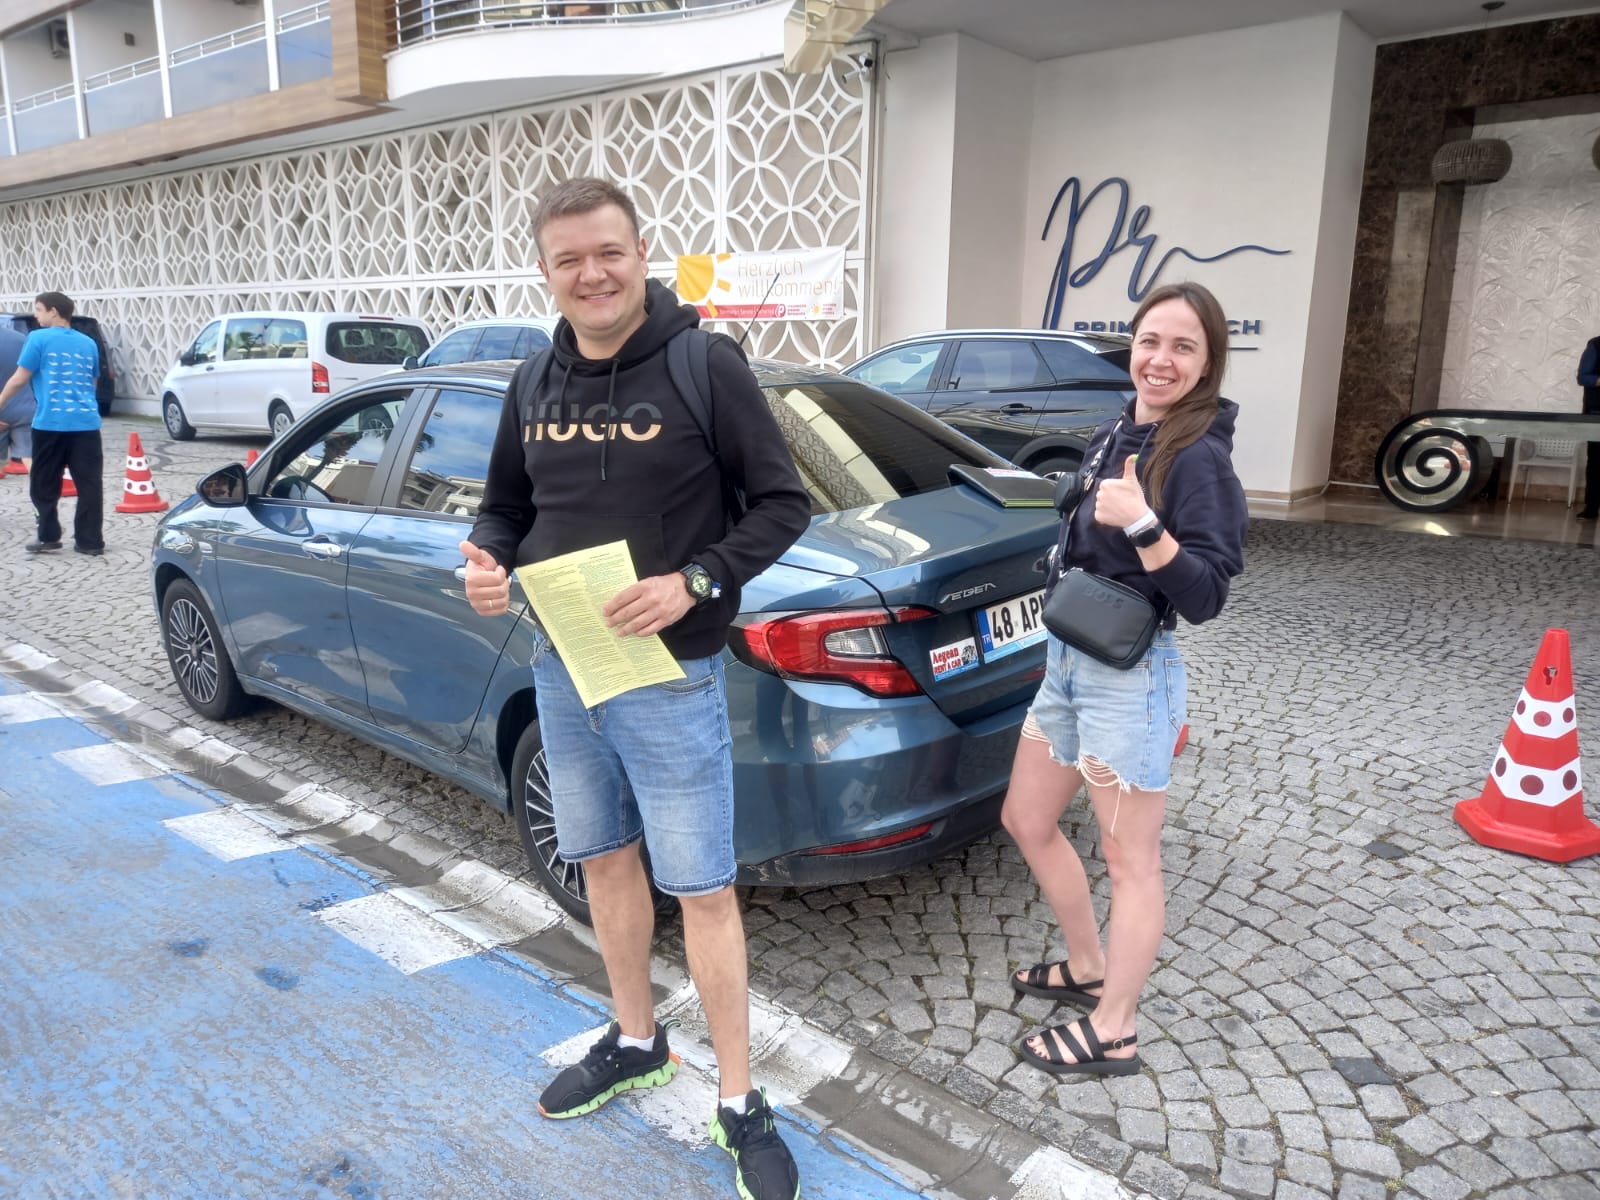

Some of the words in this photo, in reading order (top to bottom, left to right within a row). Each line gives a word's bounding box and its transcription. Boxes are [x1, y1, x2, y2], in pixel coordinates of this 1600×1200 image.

[738, 257, 803, 277] Herzlich
[738, 277, 838, 297] willkommen!
[524, 402, 663, 443] HUGO
[992, 606, 1014, 642] 48
[982, 633, 991, 644] TR
[933, 647, 960, 664] Aegean
[934, 664, 947, 674] RENT
[951, 658, 962, 668] CAR
